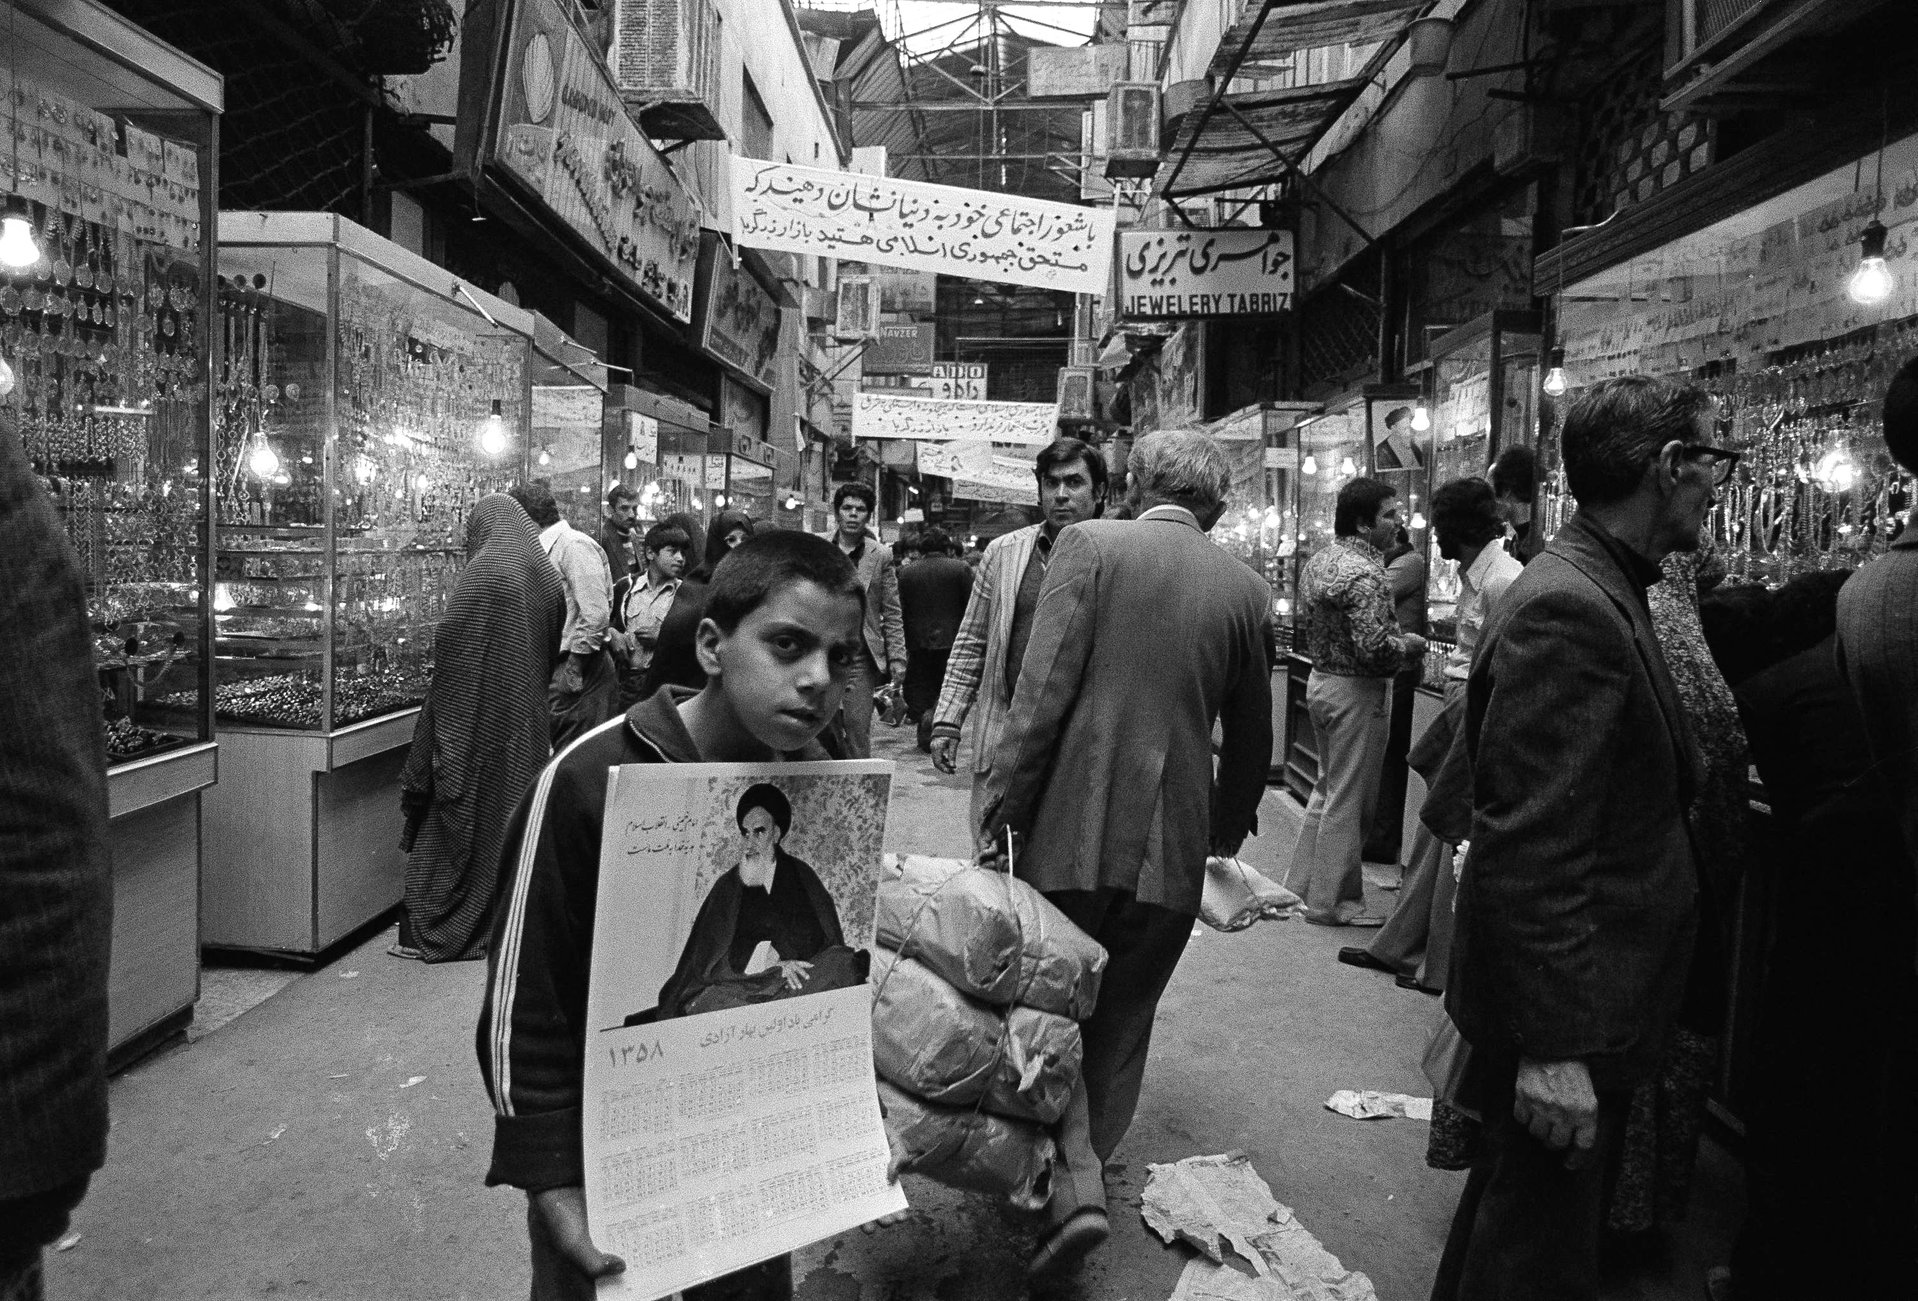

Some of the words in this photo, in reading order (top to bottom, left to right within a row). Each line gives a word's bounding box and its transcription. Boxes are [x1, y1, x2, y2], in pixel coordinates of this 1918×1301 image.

[745, 165, 781, 198] که
[827, 182, 897, 212] نشان
[899, 193, 930, 228] دنیا
[933, 211, 949, 230] به
[950, 204, 987, 229] خود
[981, 208, 1044, 238] اجتماعی
[776, 219, 812, 243] بازار
[817, 228, 874, 249] هستید
[1087, 221, 1096, 249] با
[876, 234, 947, 257] اسلامی
[950, 241, 1018, 266] جمهوری
[1018, 246, 1088, 272] مستحق
[1126, 233, 1191, 287] تبریزی
[1125, 293, 1222, 315] JEWELERY
[609, 1041, 663, 1067] ۱۳۵۸
